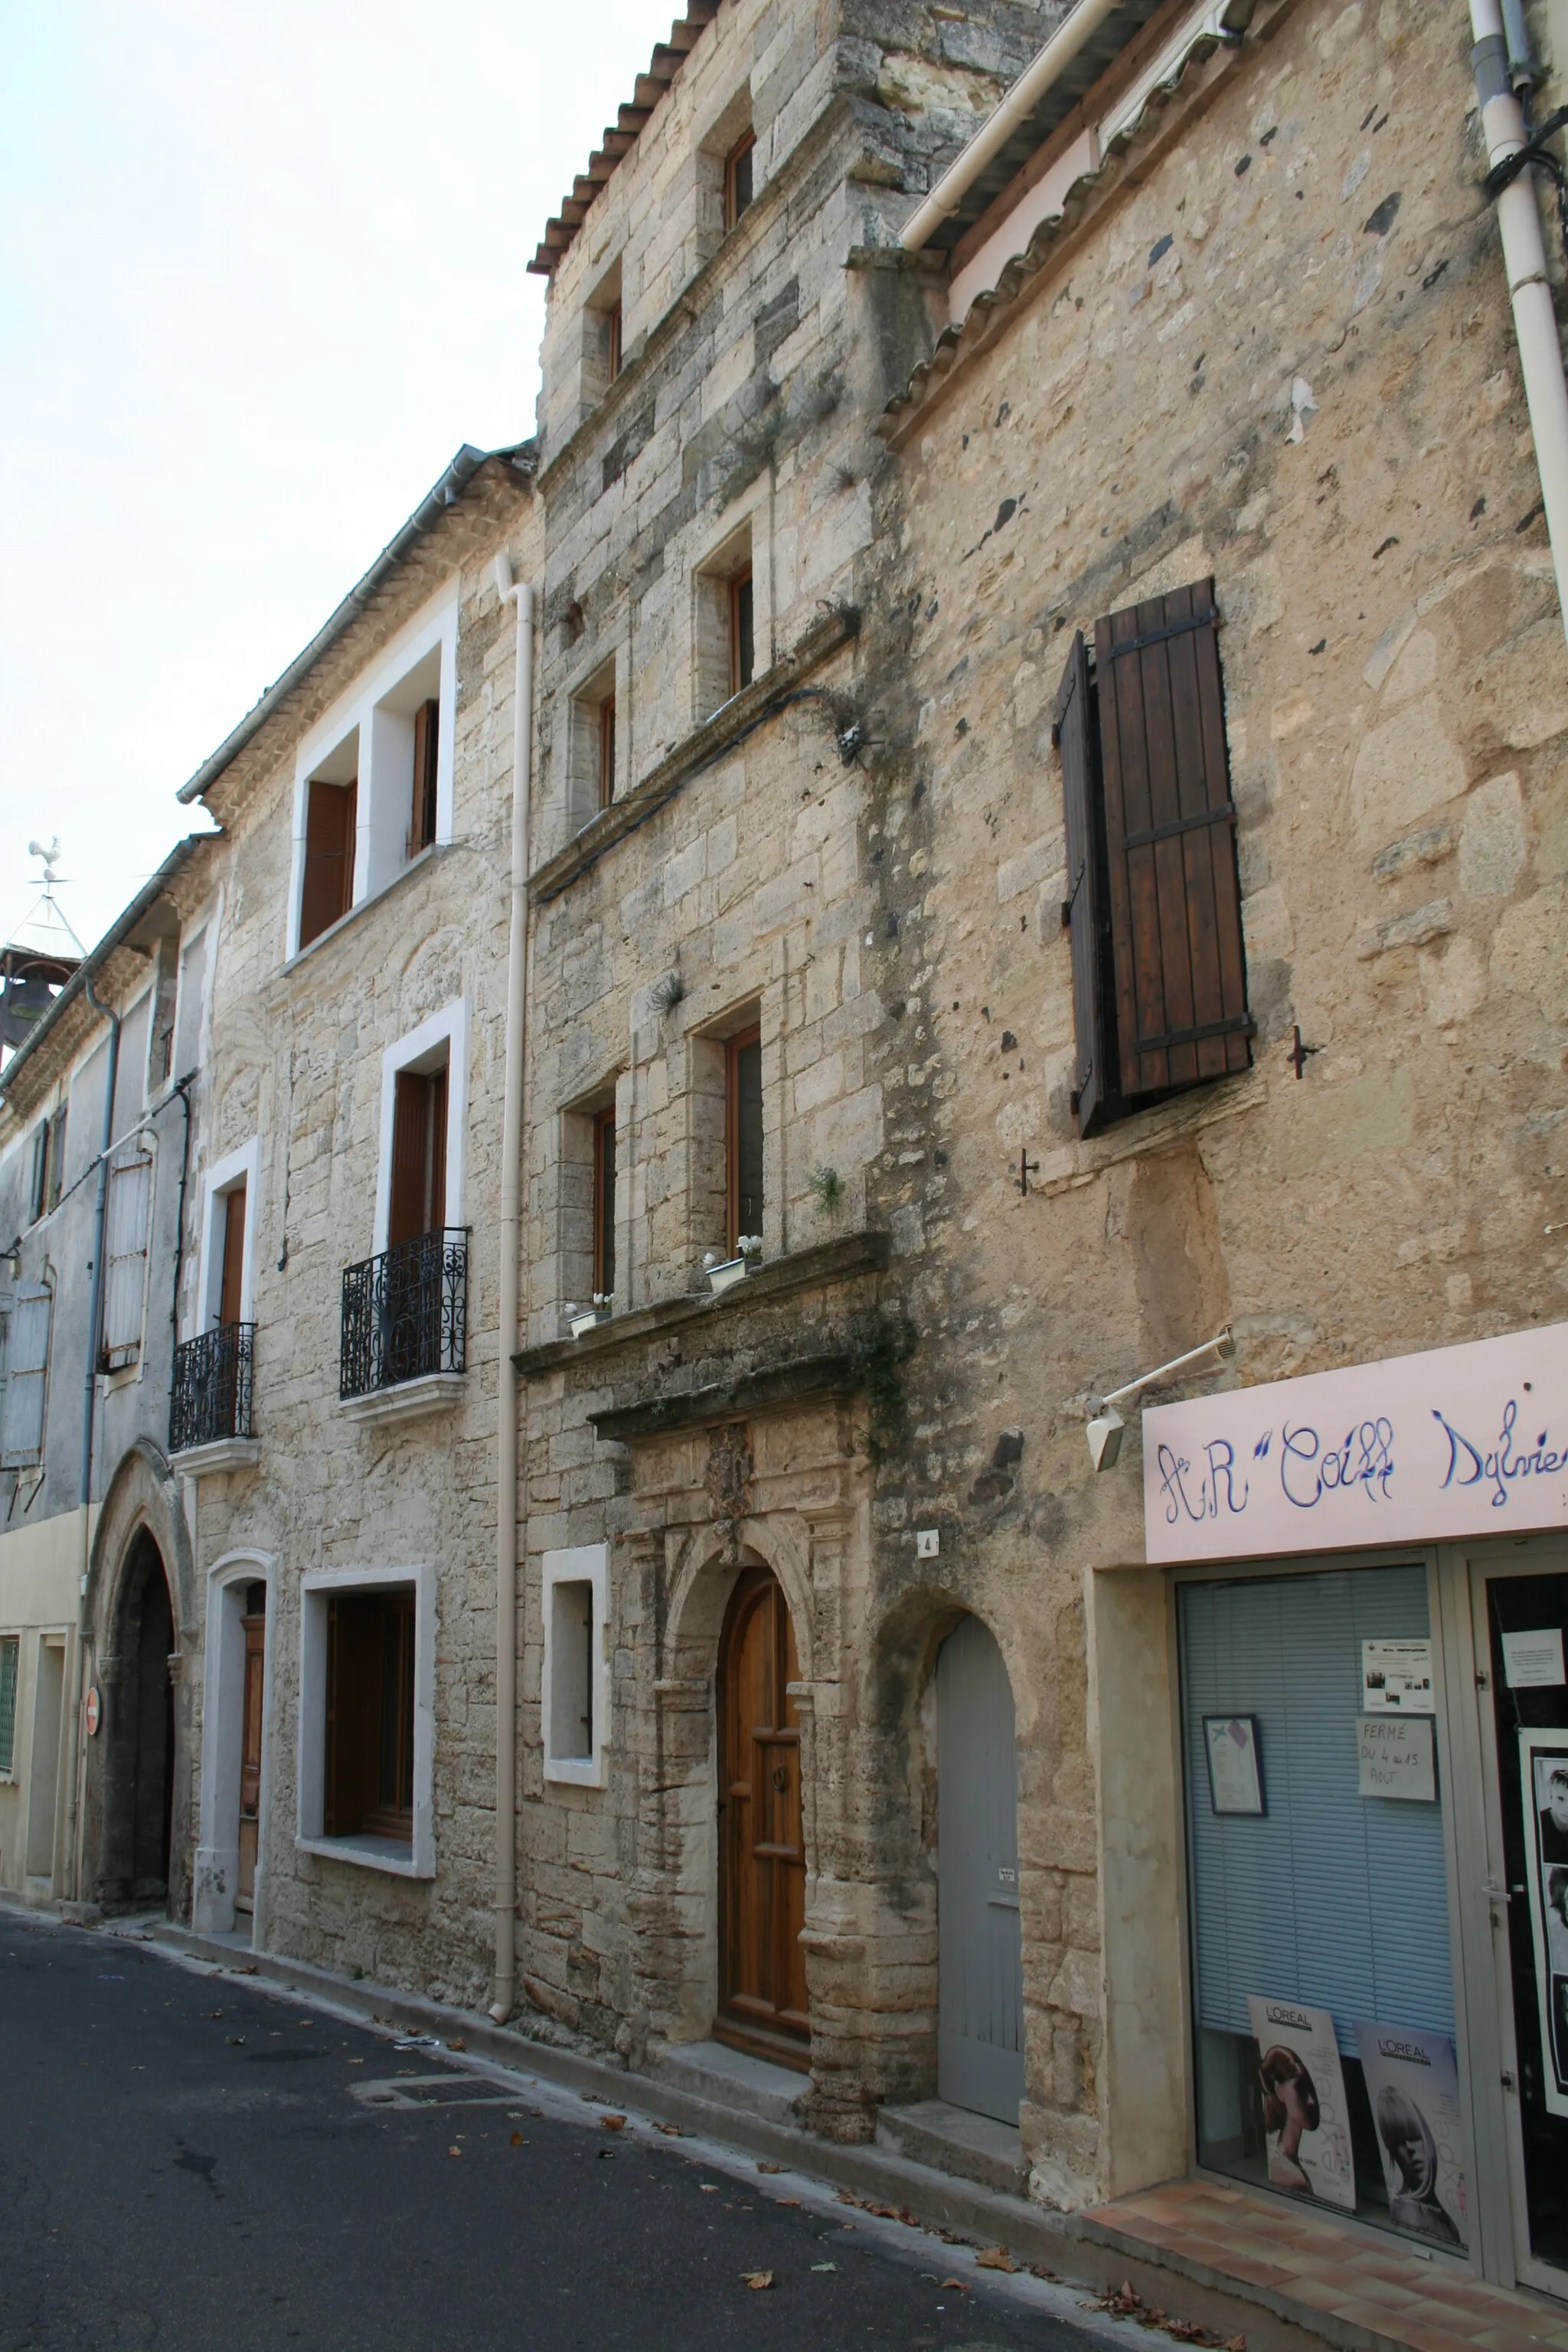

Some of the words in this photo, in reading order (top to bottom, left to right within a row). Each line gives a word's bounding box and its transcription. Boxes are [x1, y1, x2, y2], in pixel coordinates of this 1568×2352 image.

[925, 1537, 932, 1552] 4
[1364, 1722, 1406, 1741] FERMÉ
[1361, 1745, 1377, 1760] DU
[1381, 1747, 1389, 1763] 4
[1404, 1751, 1419, 1766] 15
